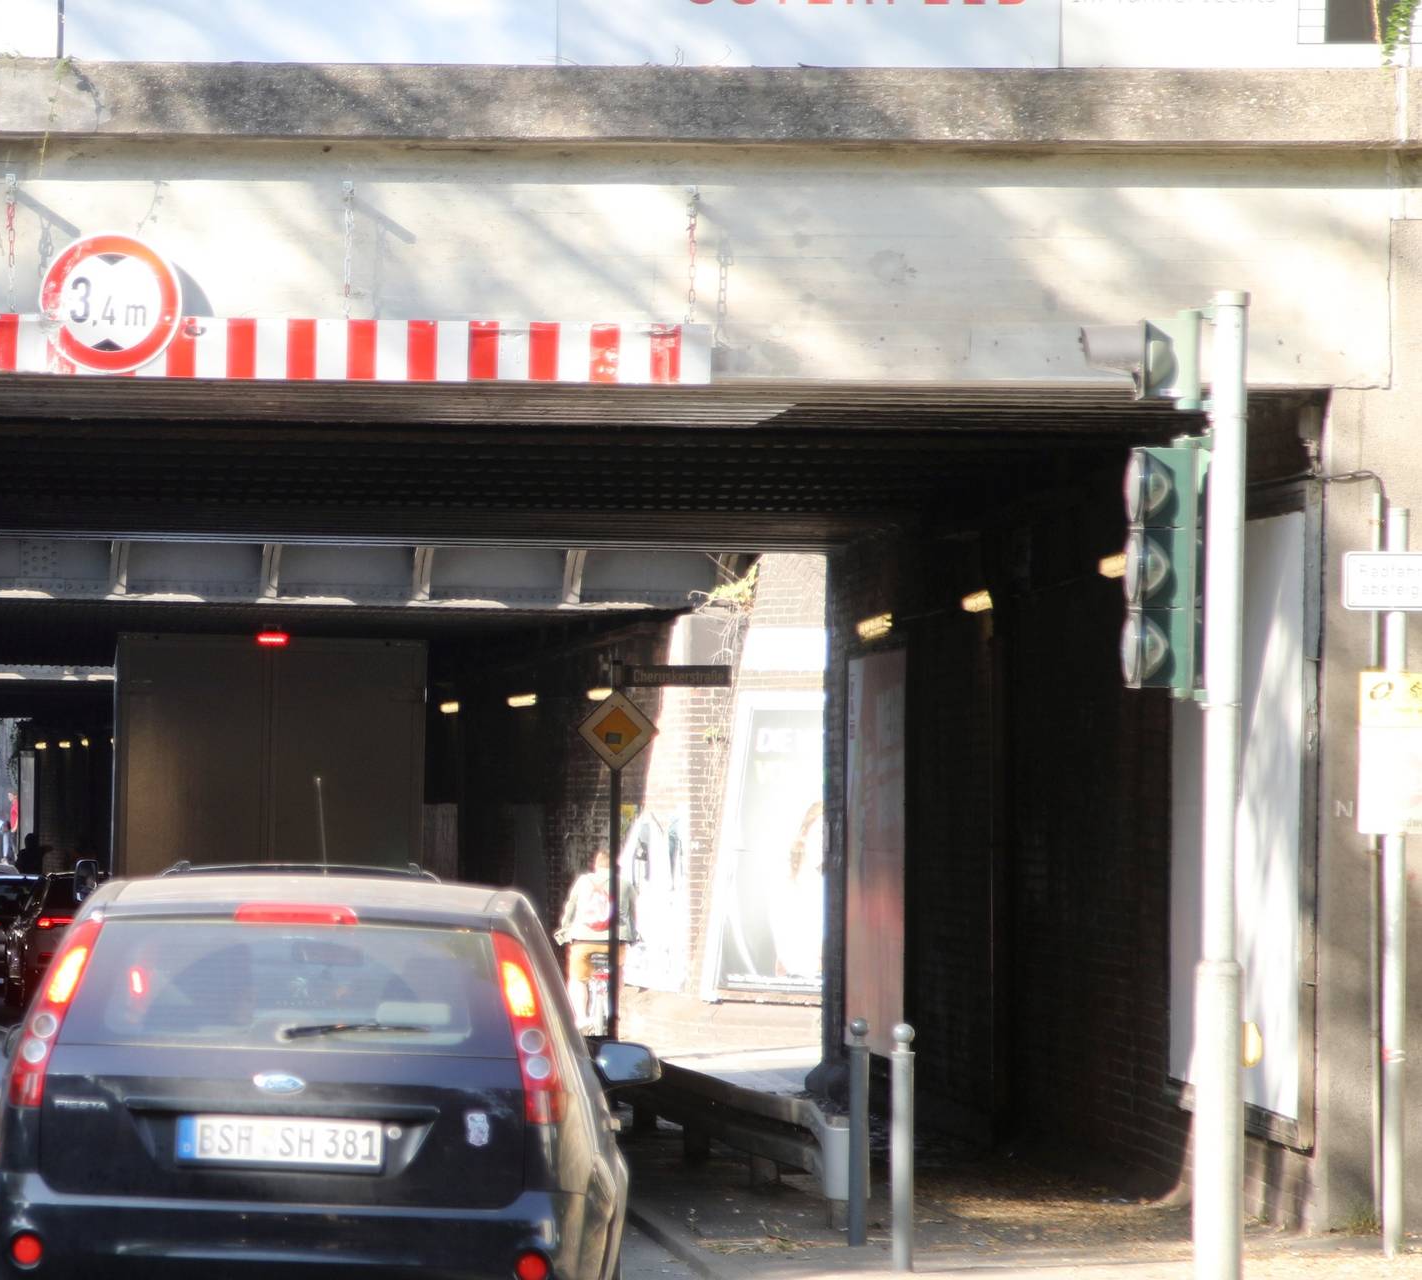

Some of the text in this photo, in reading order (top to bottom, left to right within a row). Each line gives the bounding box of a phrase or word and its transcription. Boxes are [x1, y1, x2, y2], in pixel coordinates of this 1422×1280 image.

[70, 276, 147, 327] 3,4 m
[633, 669, 725, 684] Cheruskerstraße
[198, 1123, 377, 1161] BSH SH 381
